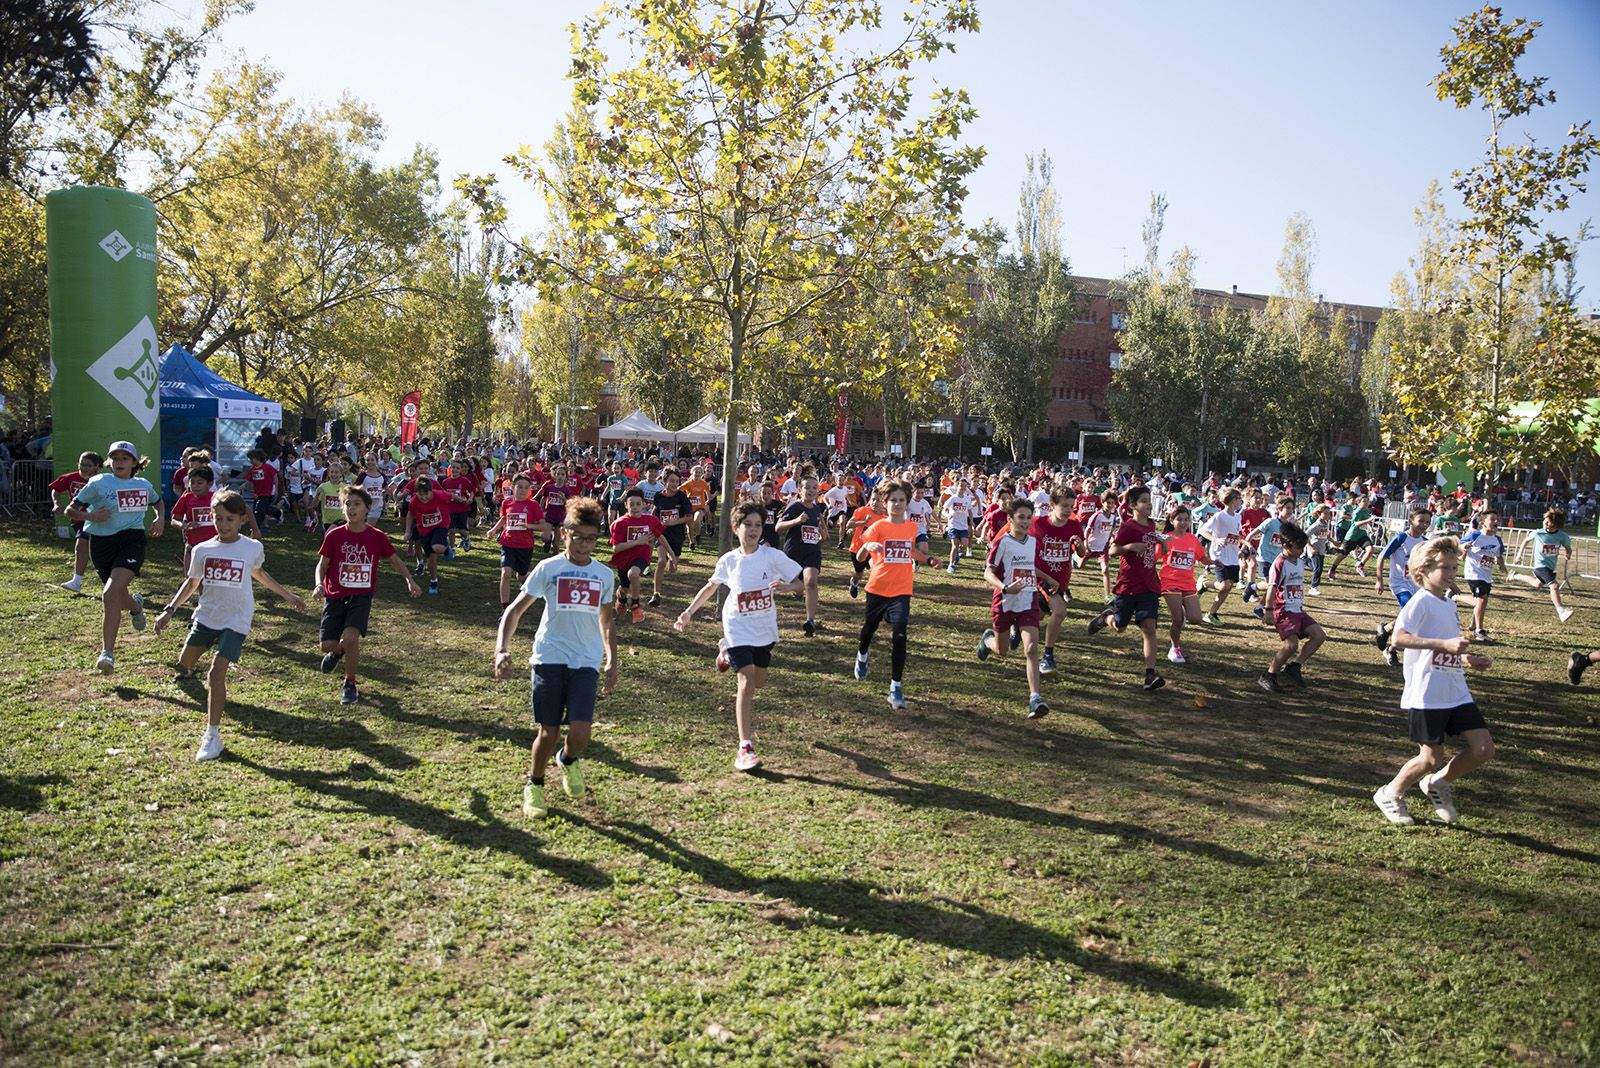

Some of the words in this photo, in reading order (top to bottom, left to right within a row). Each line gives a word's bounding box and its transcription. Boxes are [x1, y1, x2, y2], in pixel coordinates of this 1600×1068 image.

[121, 497, 146, 507] 1924
[886, 548, 910, 558] 2779
[1172, 557, 1192, 566] 1045
[206, 567, 241, 582] 3642
[342, 571, 369, 582] 2519
[570, 590, 590, 604] 92
[740, 597, 771, 611] 1485
